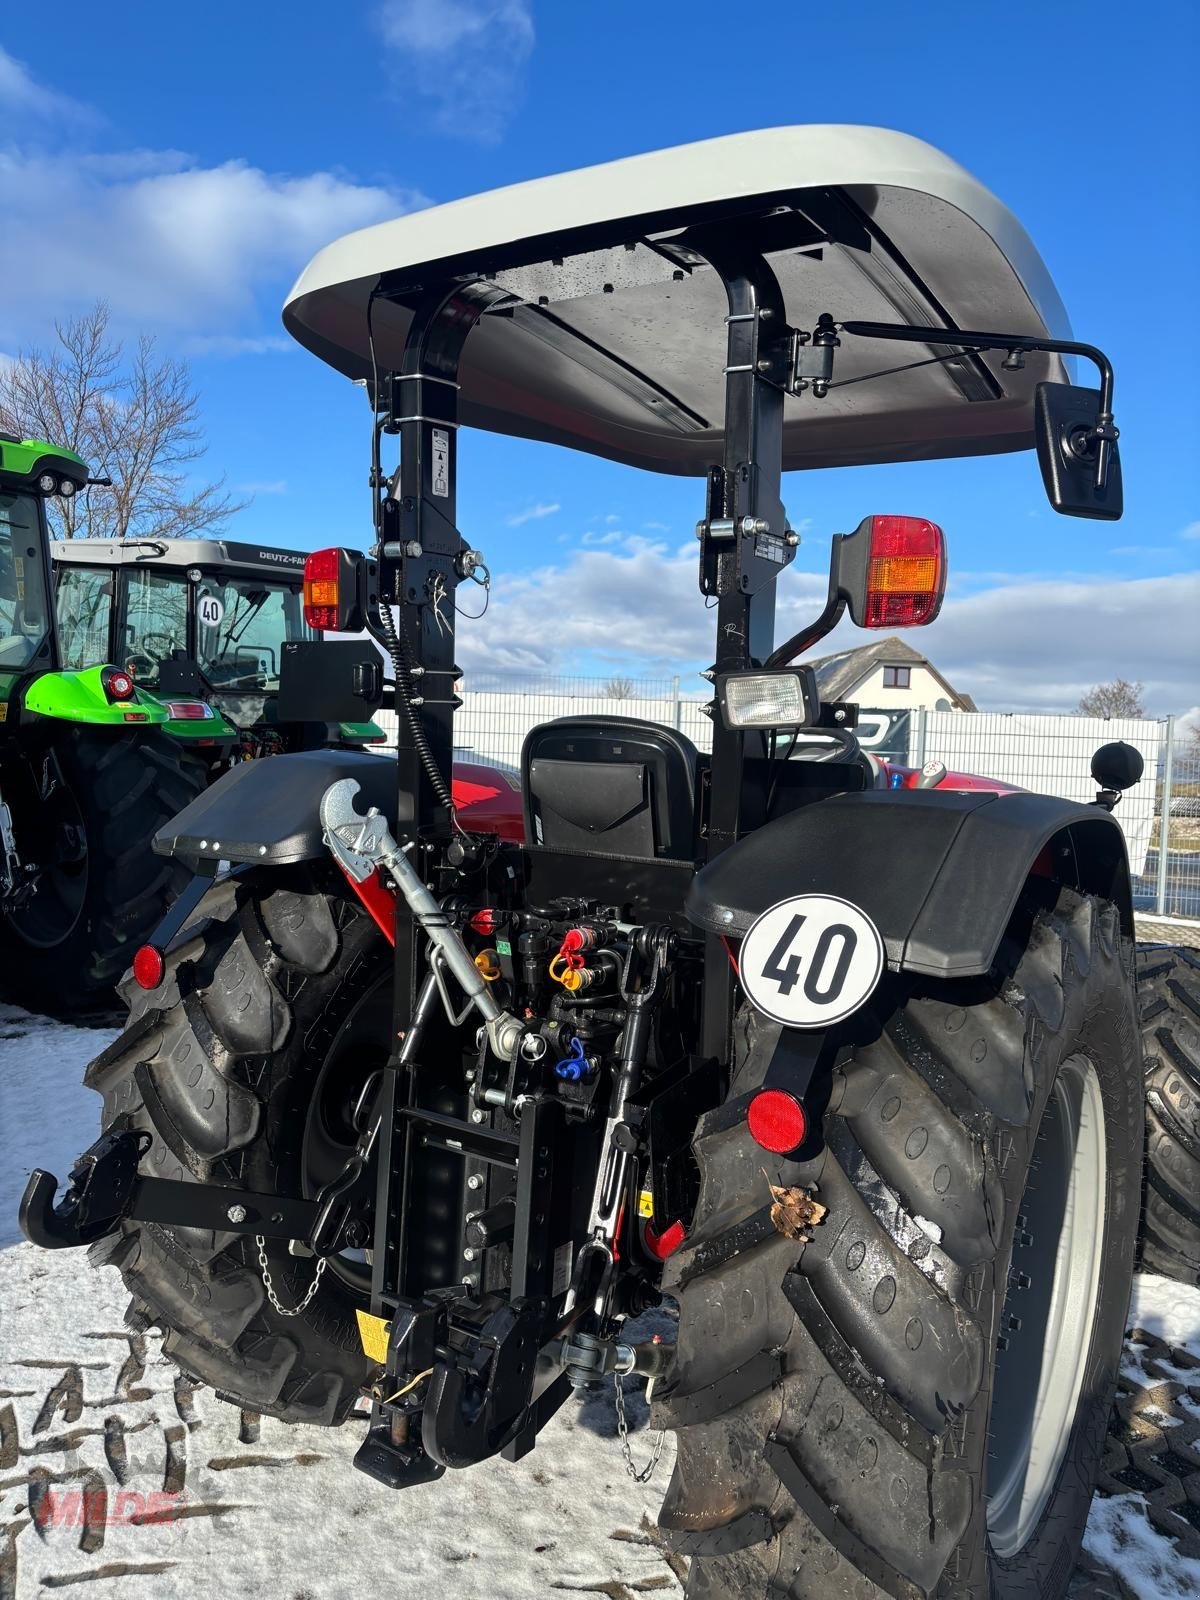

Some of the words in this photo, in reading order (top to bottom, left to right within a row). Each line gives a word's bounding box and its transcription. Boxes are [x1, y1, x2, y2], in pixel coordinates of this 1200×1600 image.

[259, 551, 306, 565] DEUTZ-FAH
[203, 601, 218, 621] 40
[761, 913, 857, 1004] 40
